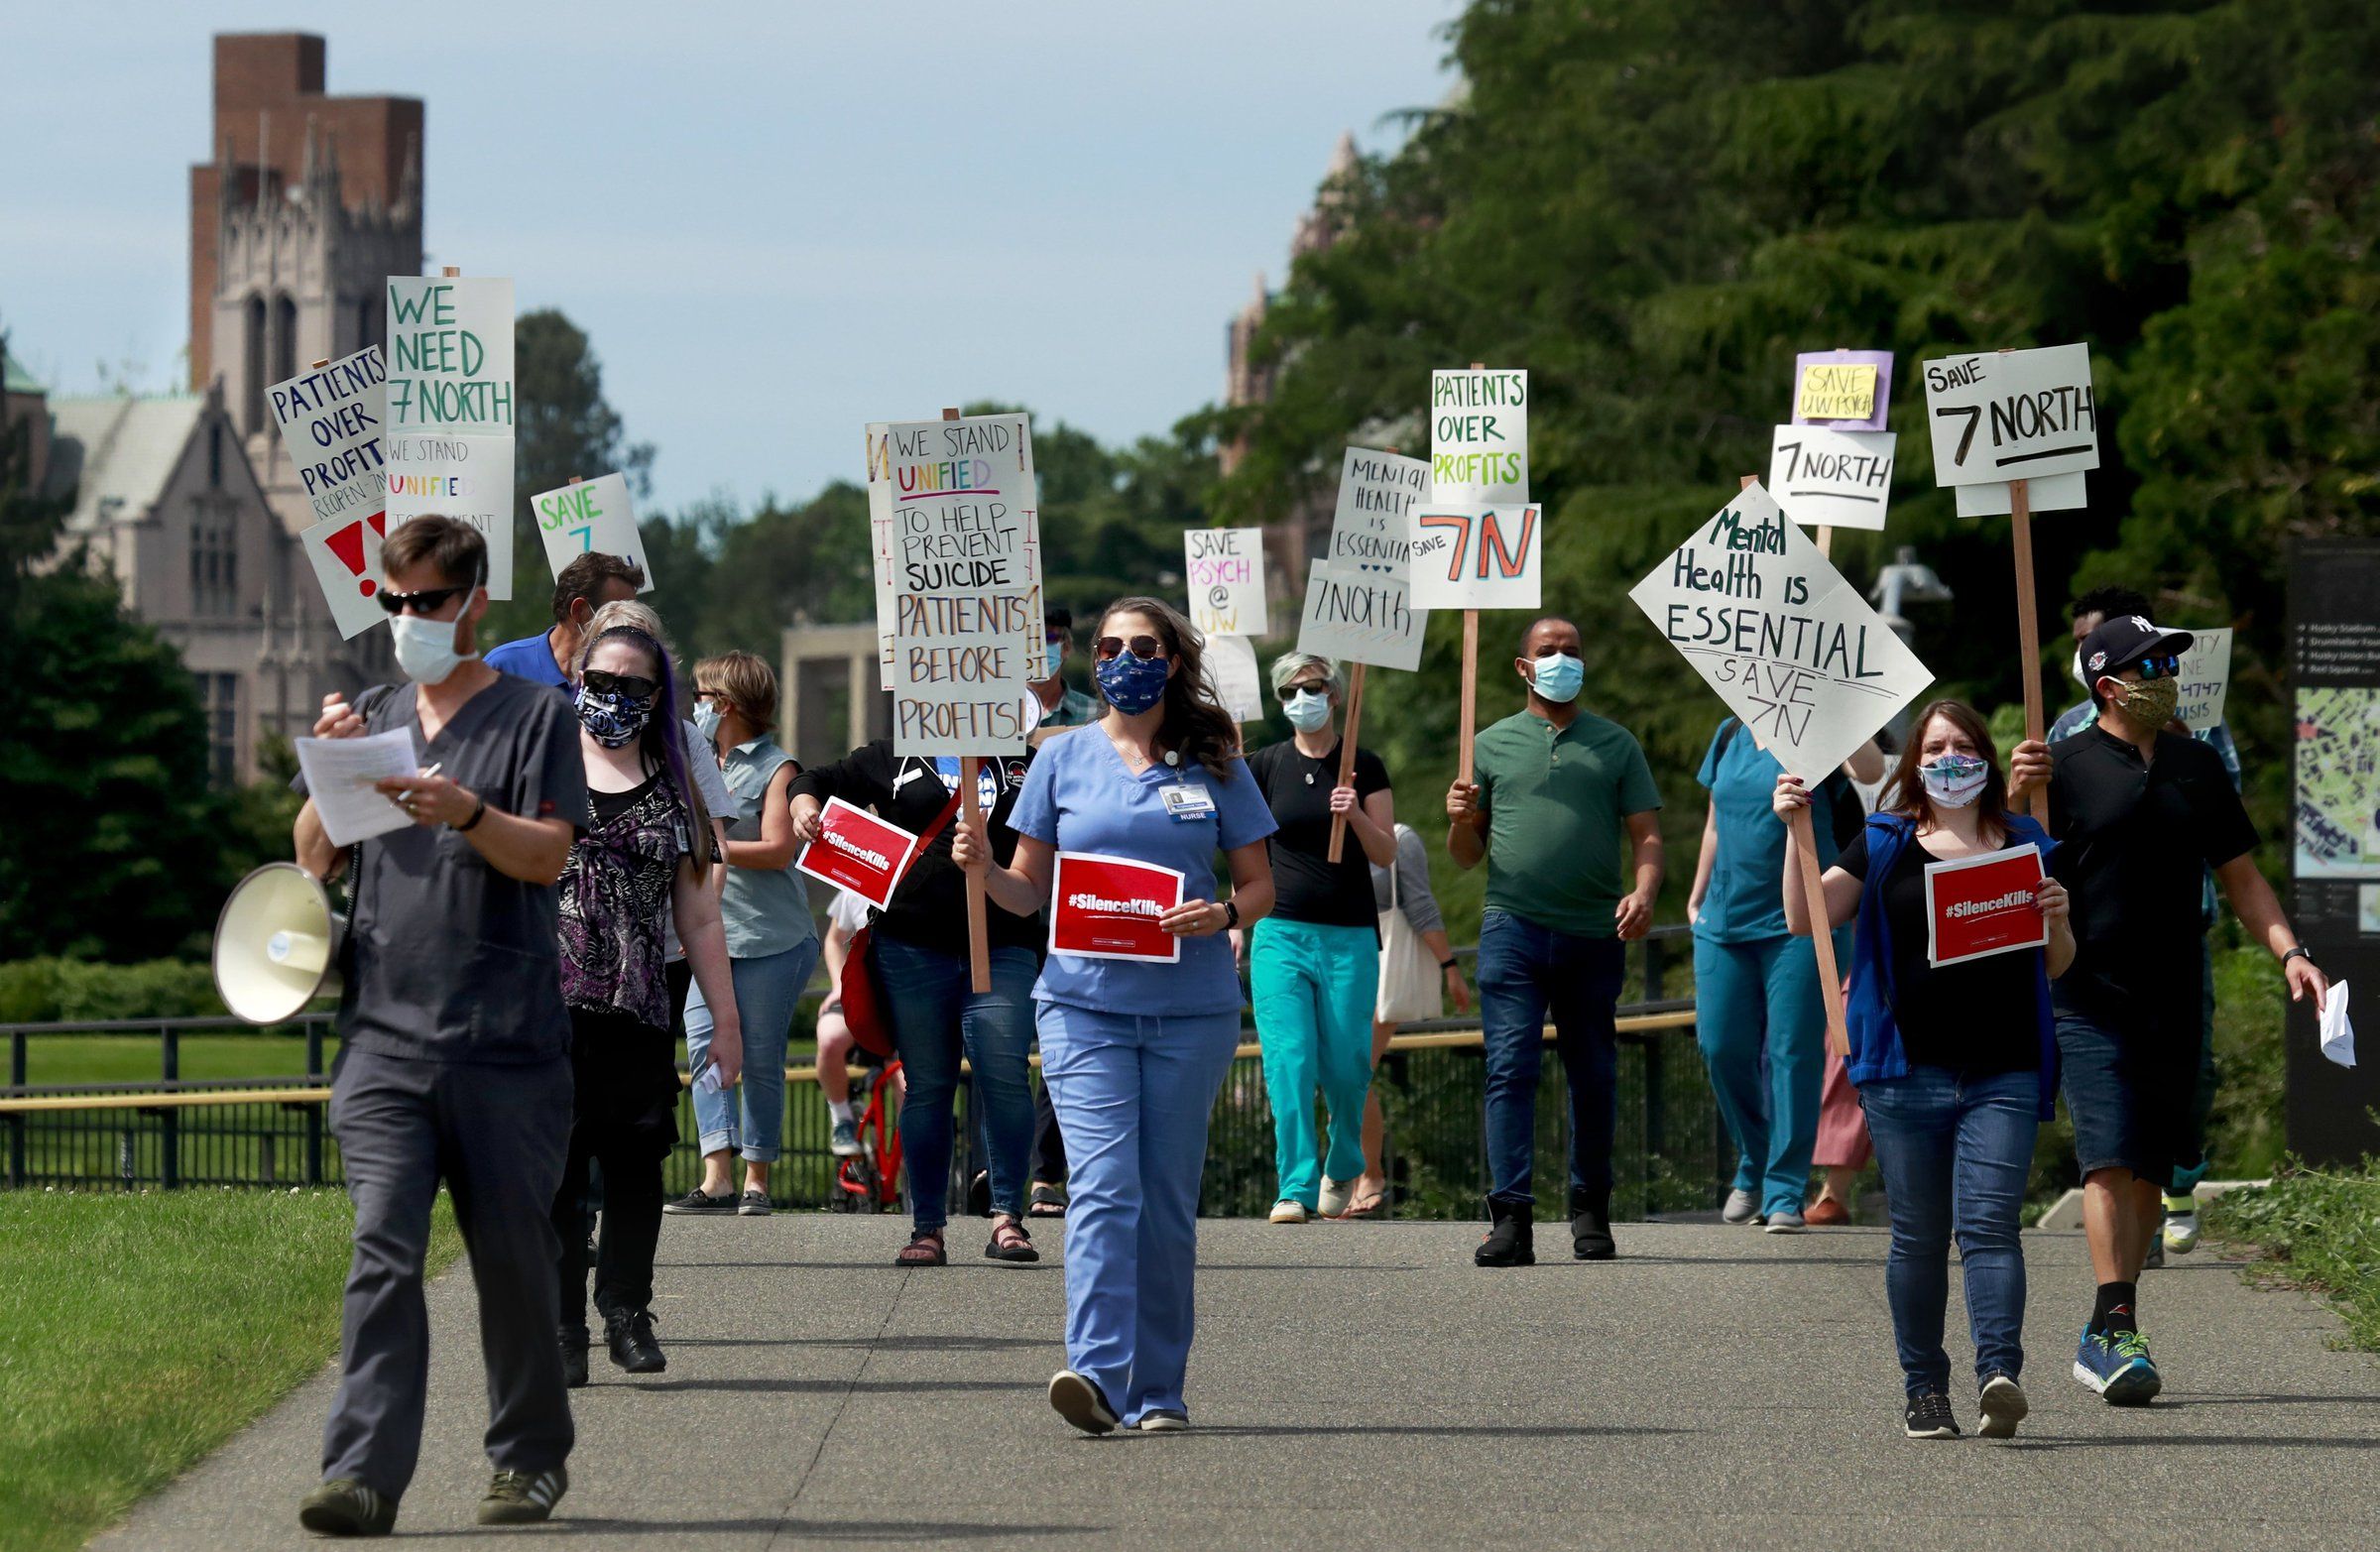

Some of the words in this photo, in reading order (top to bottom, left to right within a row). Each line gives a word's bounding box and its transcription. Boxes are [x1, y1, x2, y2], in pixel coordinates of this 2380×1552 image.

[390, 285, 456, 325] WE
[396, 330, 484, 377] NEED
[272, 349, 387, 424] PATIENTS
[1433, 373, 1525, 409] PATIENTS
[1807, 366, 1867, 394] SAVE
[1927, 357, 1987, 394] SAVE
[388, 379, 413, 423] 7
[418, 380, 513, 425] NORTH
[310, 402, 379, 447] OVER
[895, 428, 931, 458] WE
[943, 423, 1010, 457] STAND
[1437, 415, 1506, 443] OVER
[1936, 405, 1982, 468] 7
[1989, 385, 2096, 447] NORTH
[389, 439, 410, 461] WE
[416, 440, 468, 462] STAND
[1433, 451, 1522, 486] PROFITS
[1778, 441, 1803, 483] 7
[1803, 452, 1892, 488] NORTH
[389, 474, 476, 497] UNIFIED
[897, 458, 992, 492] UNIFIED
[540, 485, 604, 531] SAVE
[894, 507, 930, 535] TO
[941, 502, 1008, 534] HELP
[900, 528, 1018, 564] PREVENT
[1192, 531, 1242, 559] SAVE
[1336, 530, 1411, 564] ESSENTIA
[1411, 535, 1447, 558] SAVE
[1419, 507, 1540, 583] 7N
[1709, 508, 1787, 556] Mental
[904, 558, 1011, 593] SUICIDE
[1189, 558, 1250, 586] PSYCH
[1674, 546, 1762, 600] Health
[897, 594, 1027, 638] PATIENTS
[1208, 585, 1230, 611] @
[1199, 607, 1238, 635] UW
[1667, 603, 1885, 679] ESSENTIAL
[909, 646, 1012, 684] BEFORE
[1715, 657, 1816, 708] SAVE
[897, 697, 1025, 742] PROFITS!
[1746, 695, 1813, 748] 7N
[1180, 812, 1207, 821] NURSE
[822, 830, 892, 872] #SilenceKills
[1068, 893, 1164, 918] #SilenceKills
[1945, 889, 2034, 919] #SilenceKills
